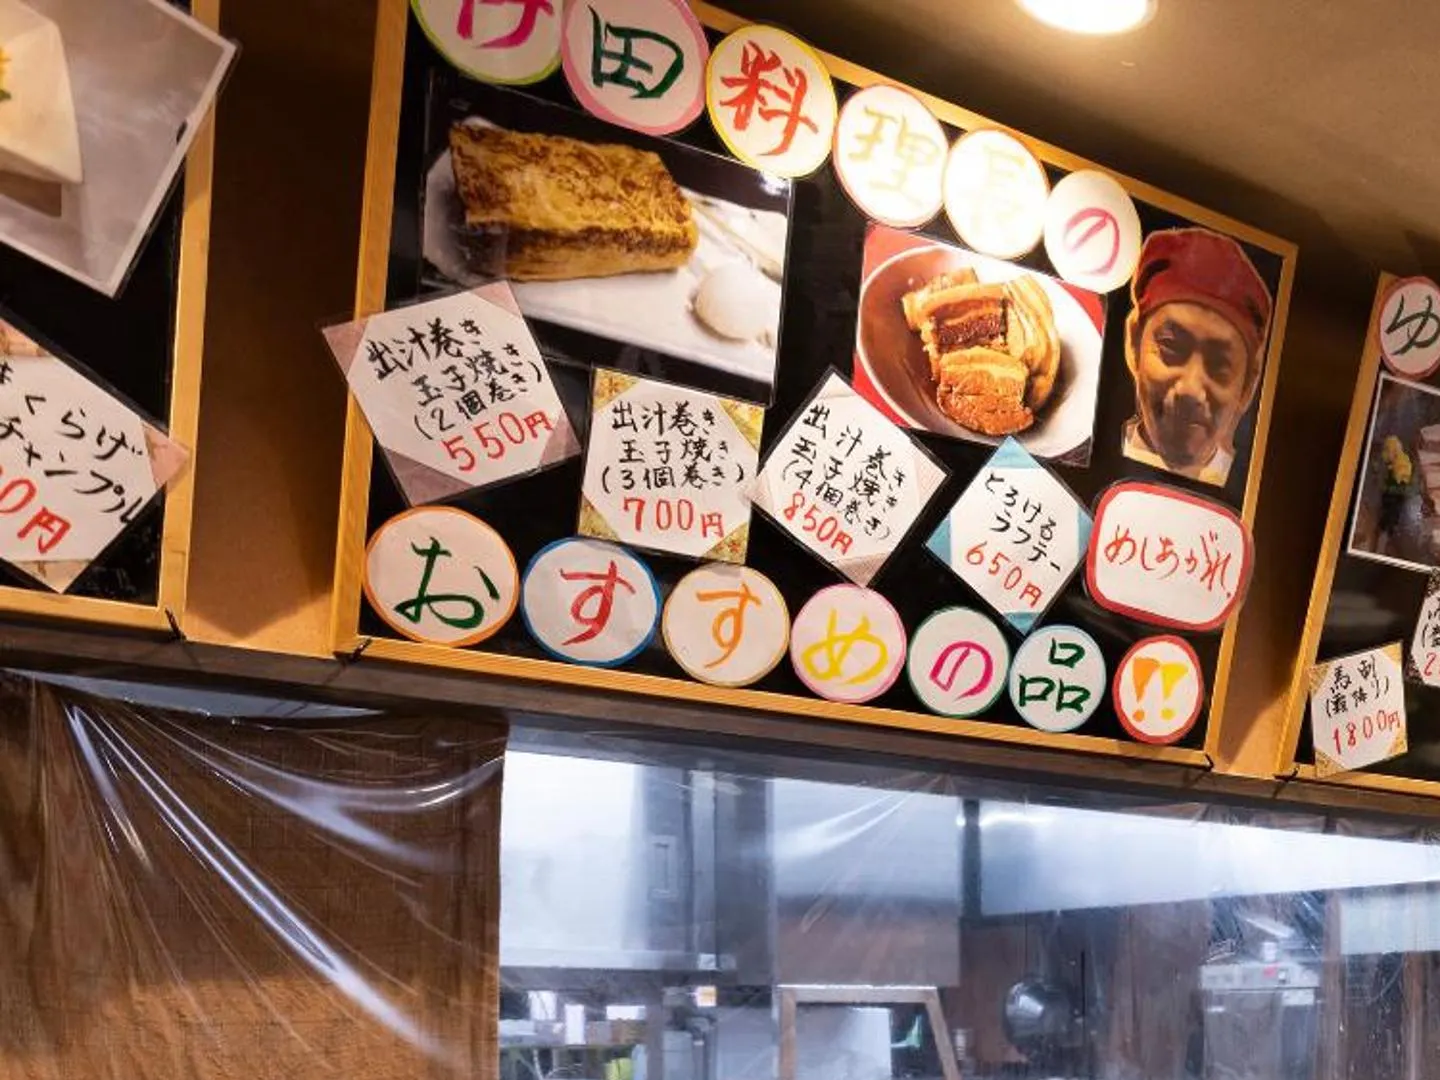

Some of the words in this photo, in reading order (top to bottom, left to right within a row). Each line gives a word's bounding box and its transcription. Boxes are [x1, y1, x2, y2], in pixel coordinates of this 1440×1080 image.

[366, 318, 482, 381] 出汁巻き
[412, 343, 523, 407] 玉子焼き
[444, 409, 554, 472] 550円
[612, 401, 716, 436] 出汁巻き
[803, 405, 905, 490] 出汁巻き
[622, 437, 728, 464] 玉子焼き
[792, 436, 898, 511] 玉子焼き
[623, 497, 724, 538] 700円
[783, 493, 854, 556] 850円
[986, 474, 1055, 543] とろける
[965, 542, 1043, 608] 650円
[995, 514, 1061, 573] ラフテー
[1333, 708, 1400, 755] 1800円
